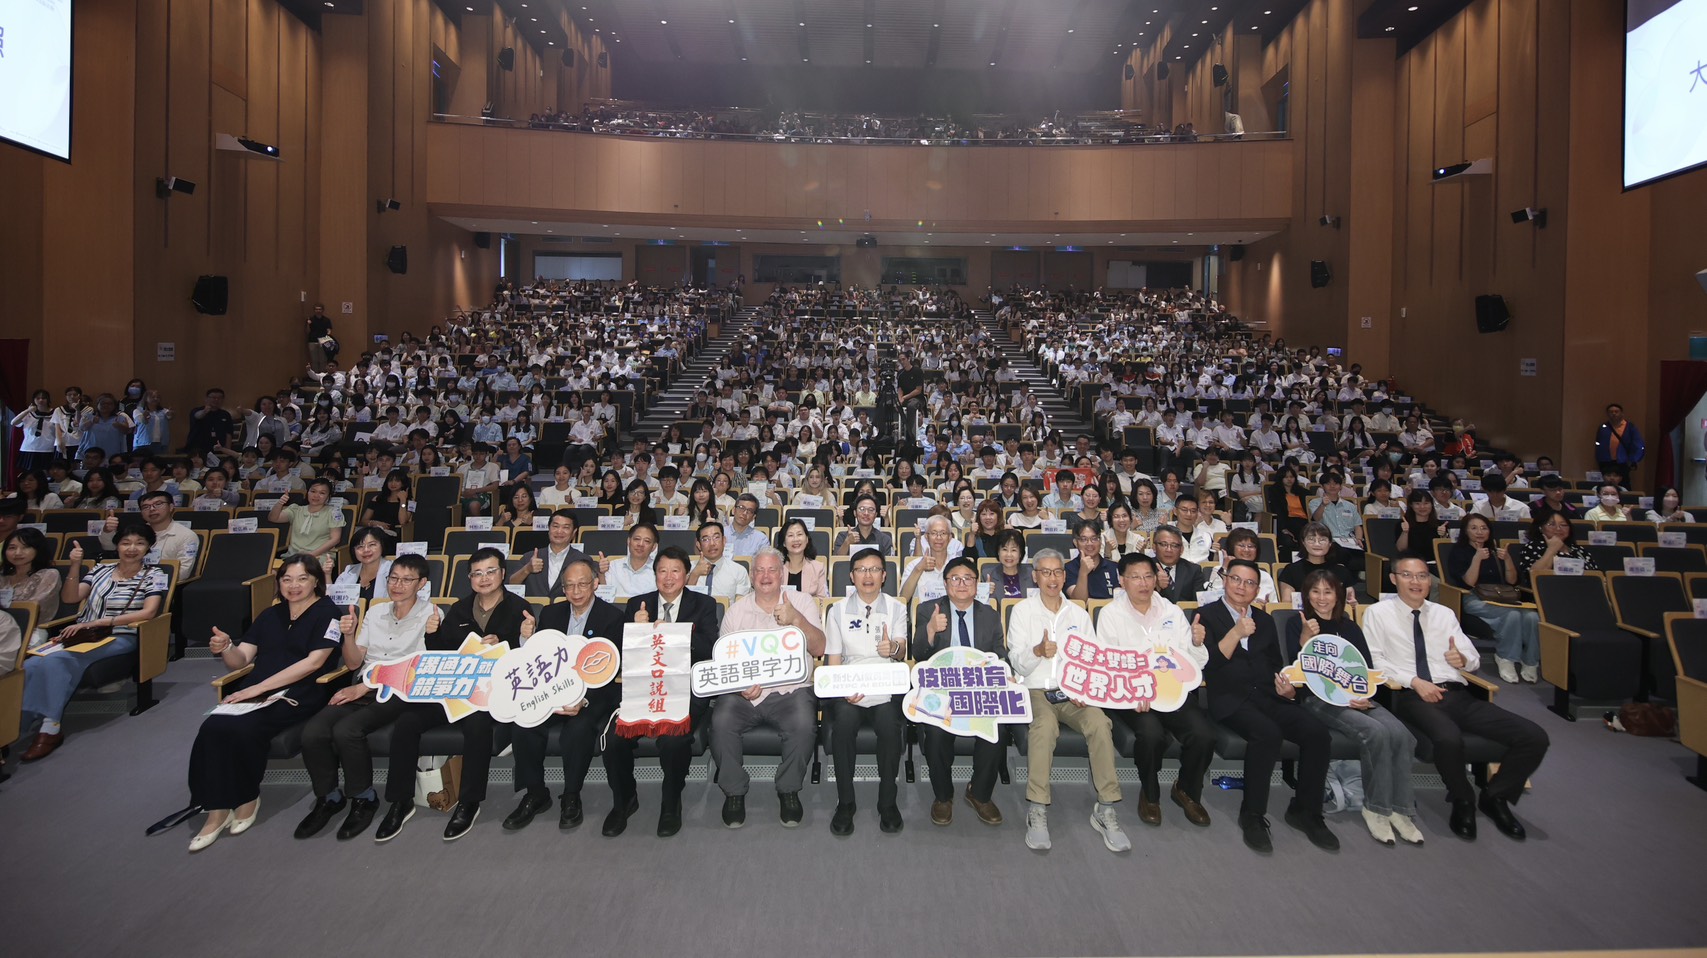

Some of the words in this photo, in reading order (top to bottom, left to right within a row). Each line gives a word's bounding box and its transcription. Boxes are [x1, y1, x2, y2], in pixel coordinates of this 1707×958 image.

[726, 631, 800, 659] #VQC
[1313, 641, 1338, 657] 走向
[505, 646, 569, 701] 英語力
[698, 654, 801, 688] 英語單字力
[918, 666, 1006, 688] 技職教育
[1063, 663, 1154, 699] 世界人才
[1301, 653, 1368, 694] 國際舞台
[410, 677, 476, 697] 競爭力
[520, 690, 550, 711] English
[552, 678, 575, 695] Skills
[949, 690, 1025, 715] 國際化
